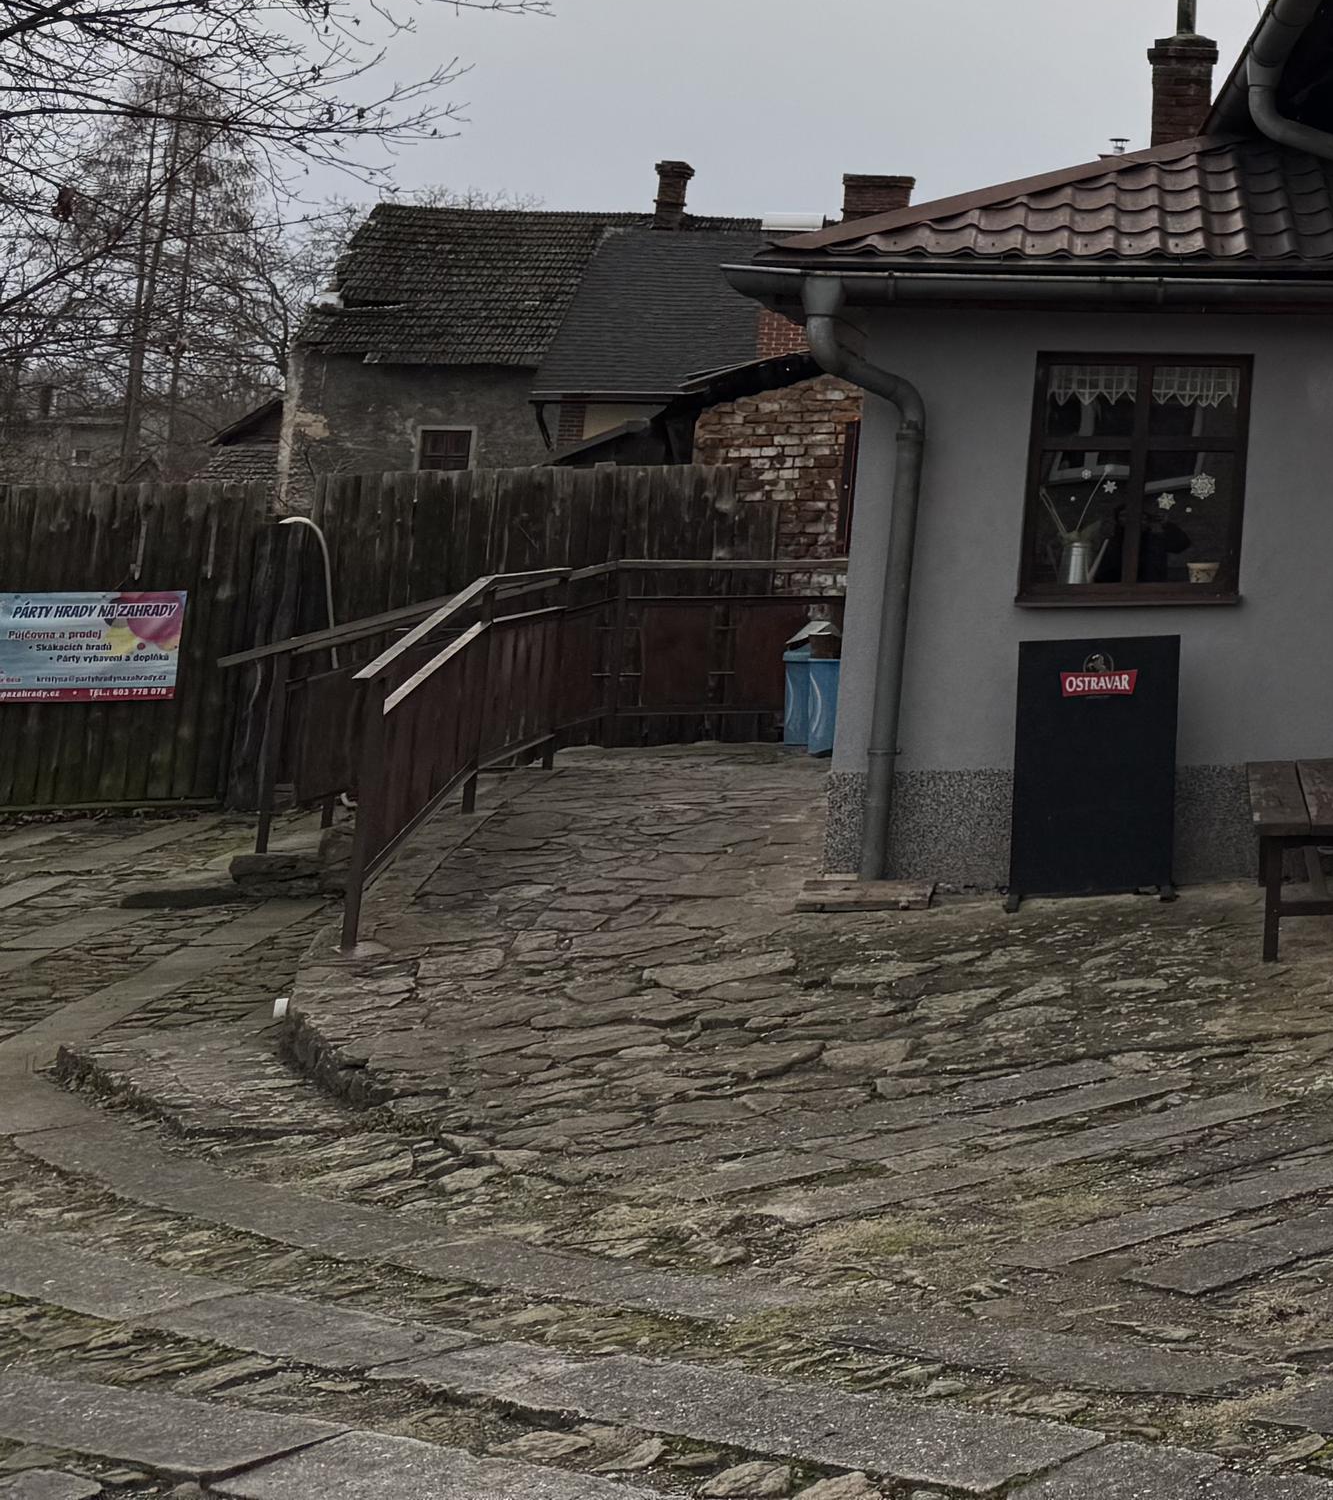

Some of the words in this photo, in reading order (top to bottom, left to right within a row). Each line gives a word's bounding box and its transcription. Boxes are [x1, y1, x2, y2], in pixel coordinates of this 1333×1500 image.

[12, 601, 52, 619] PÁRTY
[53, 605, 97, 618] HRADY
[97, 604, 116, 618] NA
[116, 603, 177, 618] ZAHRADY
[68, 630, 102, 640] prodej
[56, 654, 80, 664] Párty
[1065, 674, 1130, 692] OSTRAVAR
